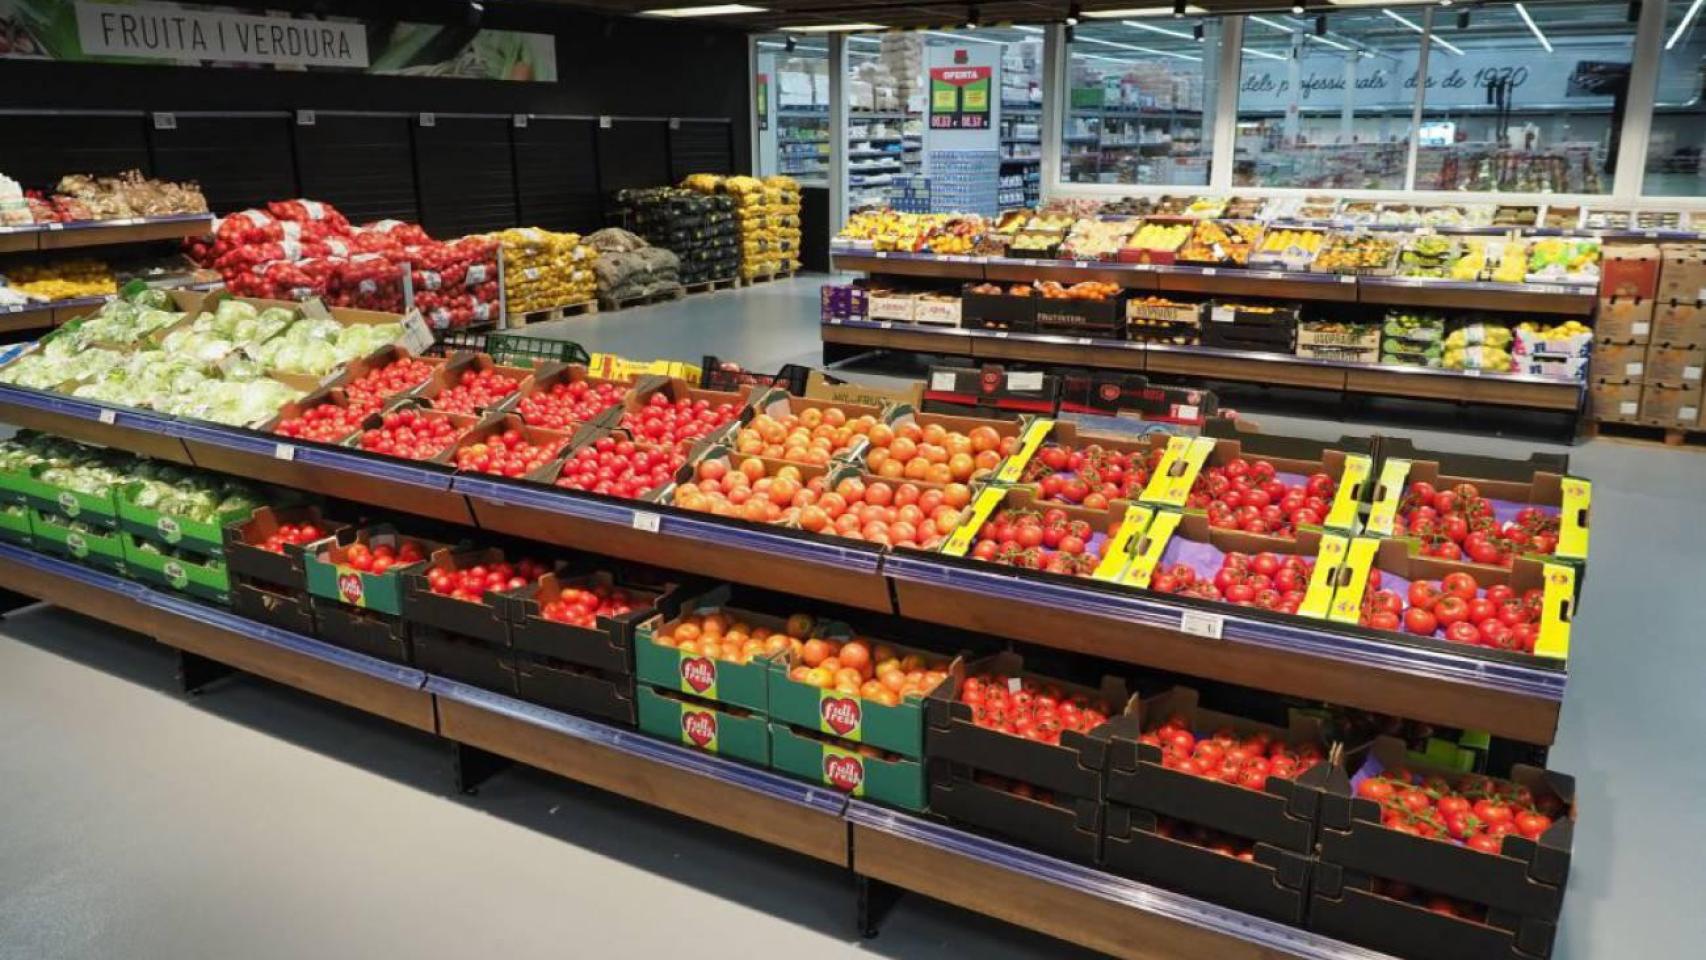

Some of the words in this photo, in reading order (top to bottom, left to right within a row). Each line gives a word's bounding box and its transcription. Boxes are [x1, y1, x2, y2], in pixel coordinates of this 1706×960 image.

[101, 12, 207, 51] FRUITA
[218, 20, 224, 50] I
[235, 23, 351, 59] VERDURA
[943, 71, 978, 80] OFERTA
[1275, 70, 1387, 99] pofessials
[1404, 68, 1437, 89] ds
